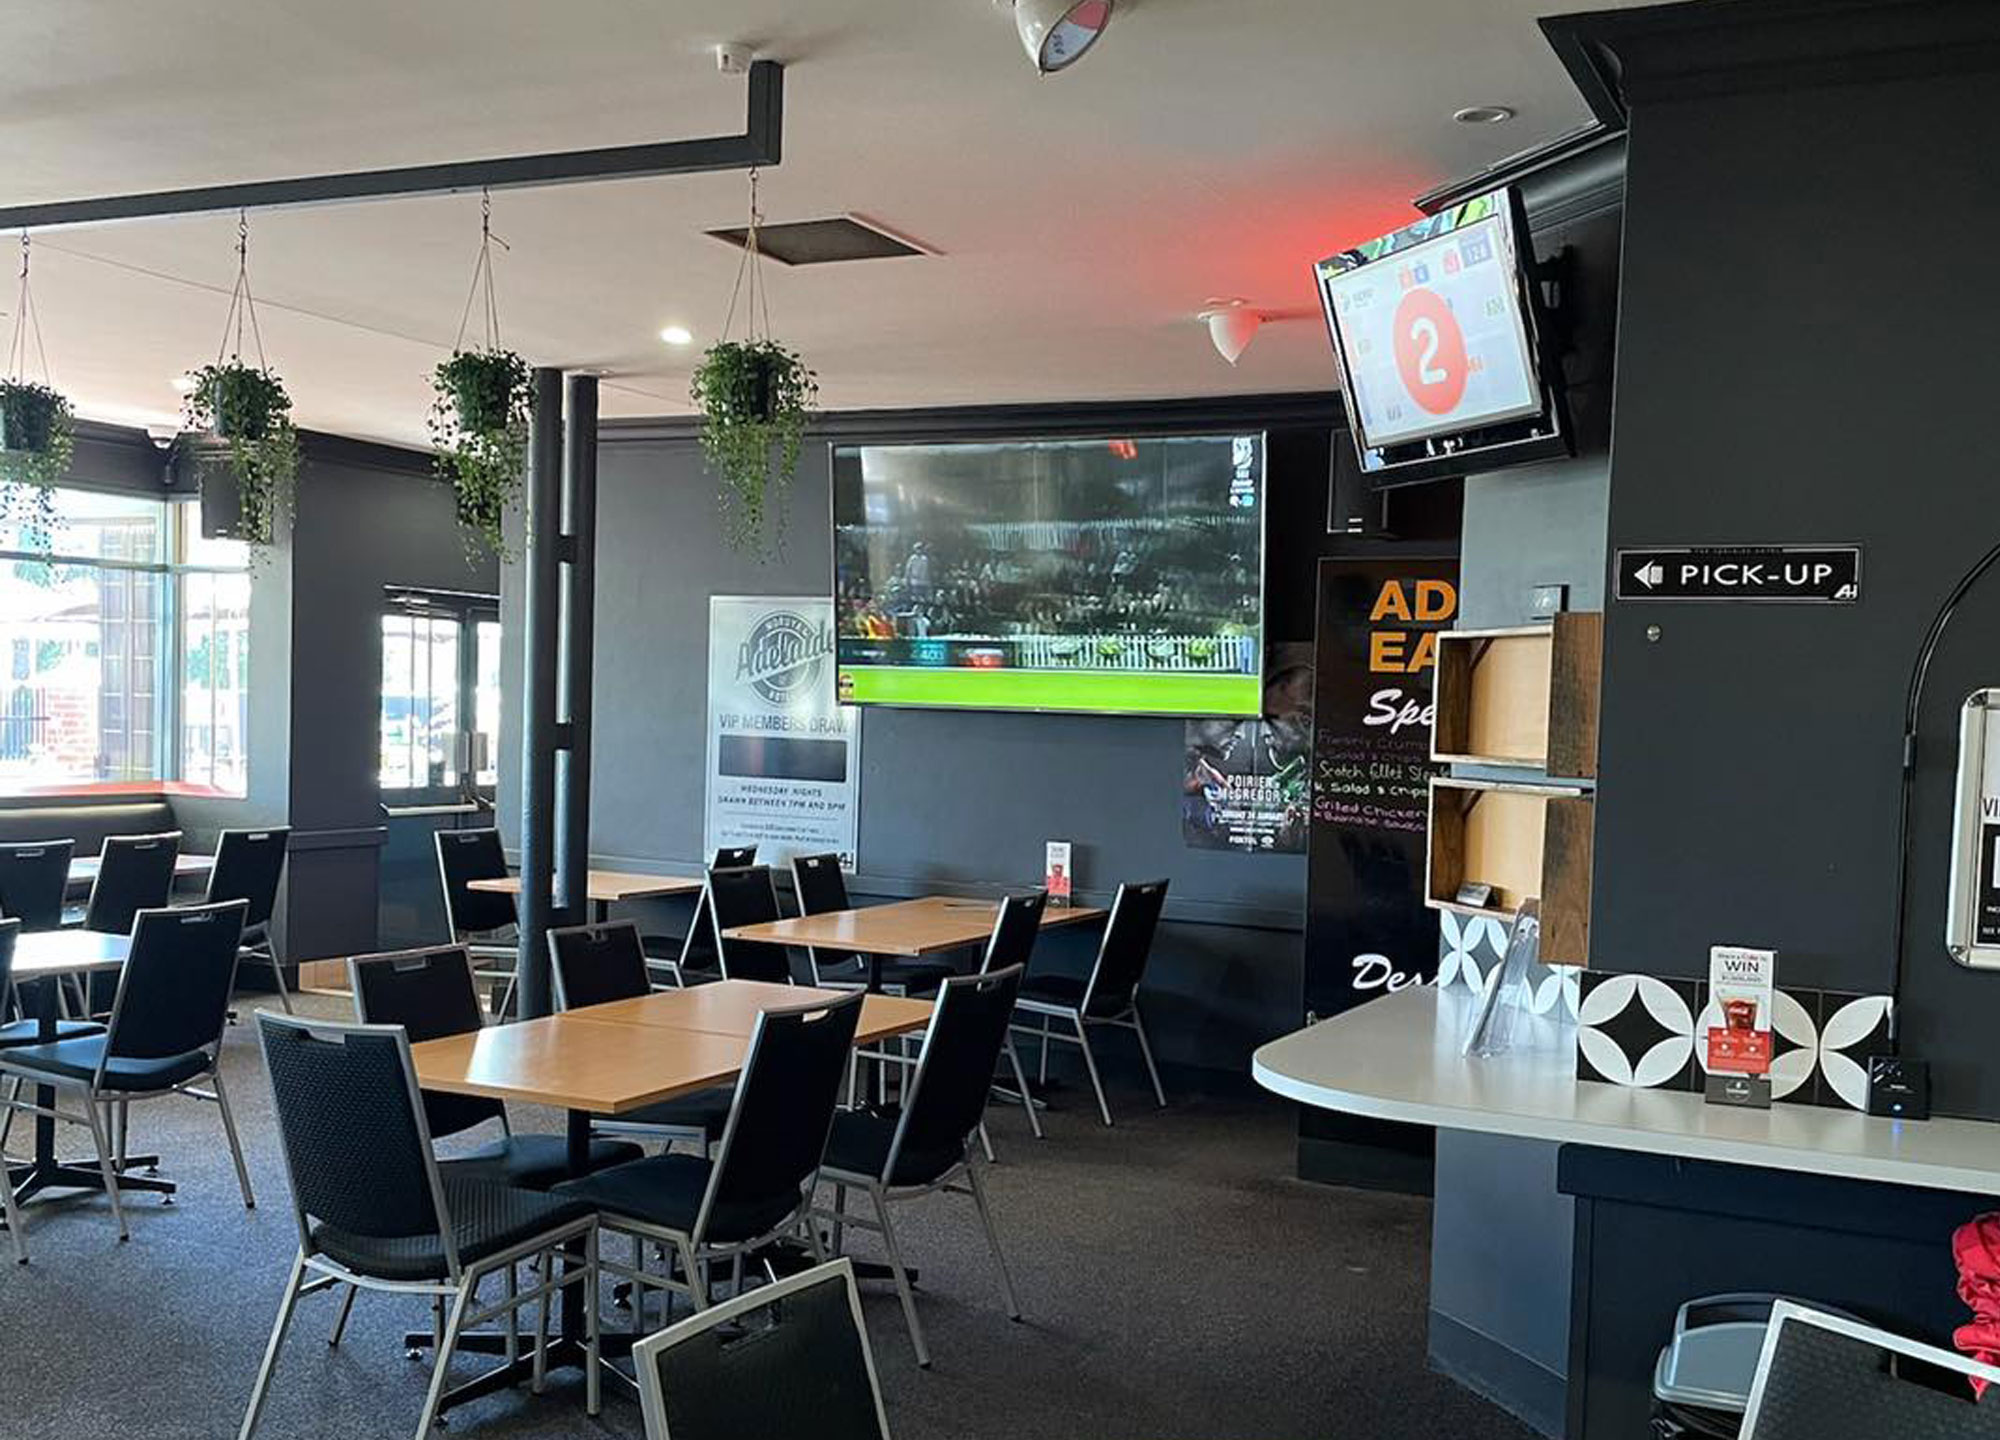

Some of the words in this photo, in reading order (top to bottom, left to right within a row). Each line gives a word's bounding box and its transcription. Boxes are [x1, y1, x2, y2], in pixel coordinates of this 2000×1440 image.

[1410, 318, 1446, 384] 2
[1680, 563, 1833, 586] PICK-UP
[719, 714, 739, 729] VIP
[748, 796, 787, 808] BETWEEN
[808, 800, 825, 811] AND
[1983, 798, 2000, 817] VI
[1724, 960, 1760, 973] WIN
